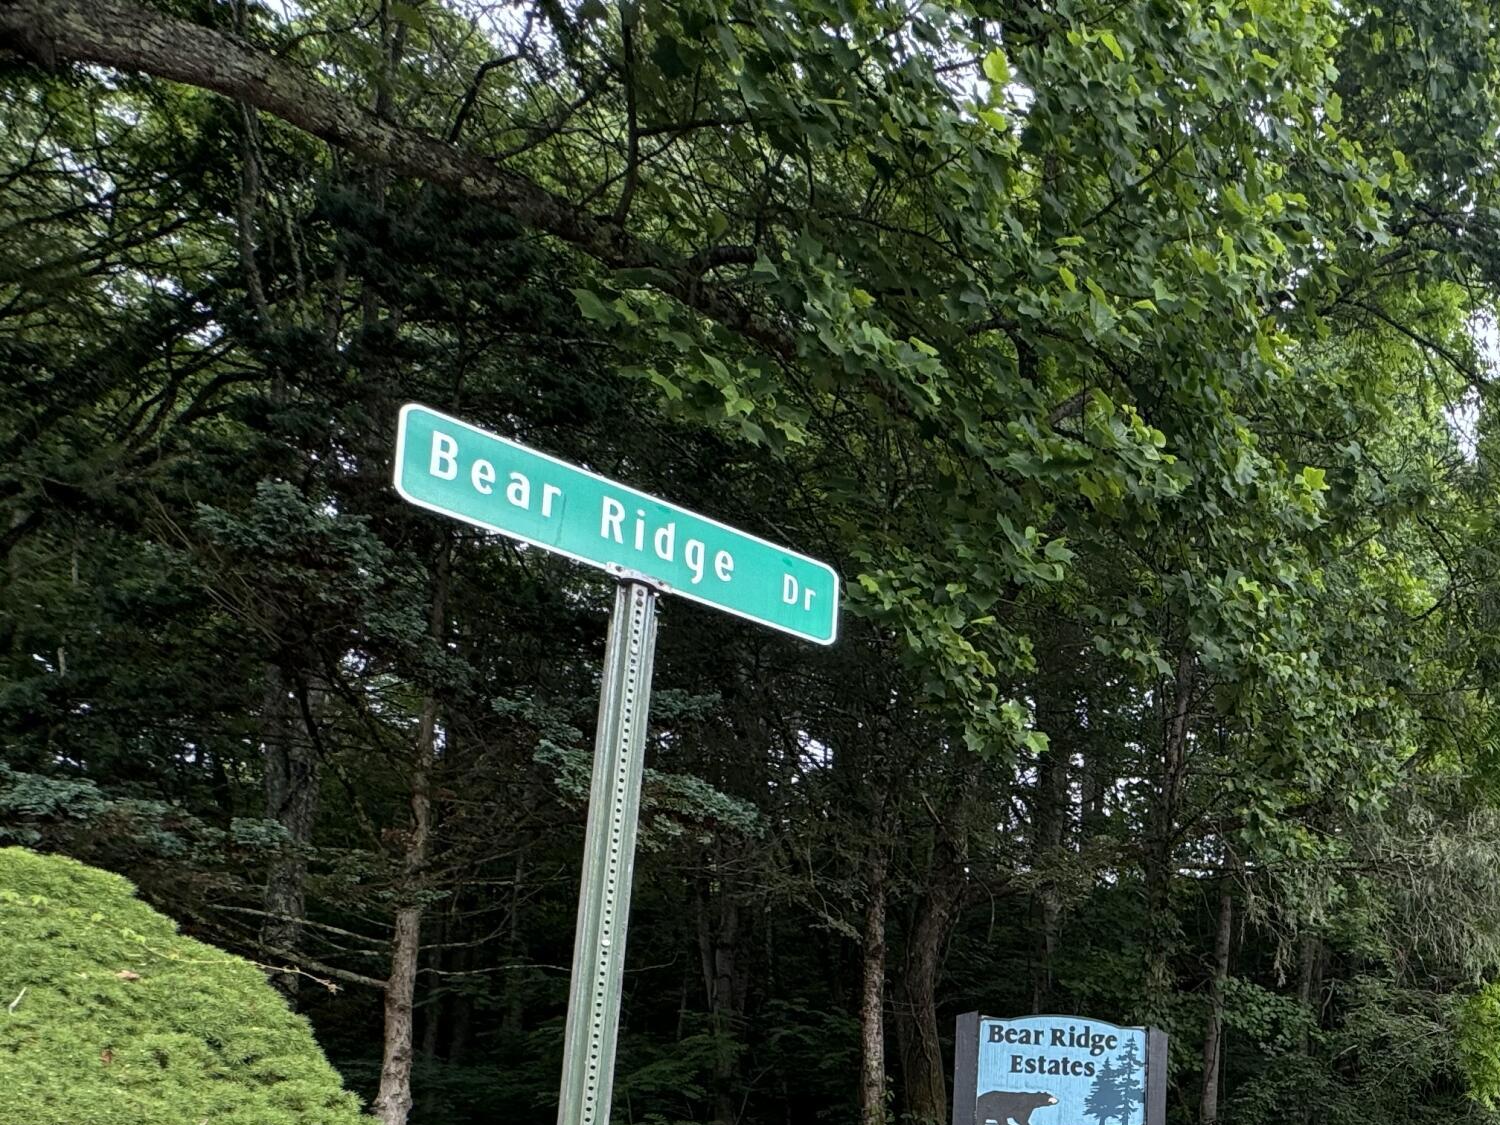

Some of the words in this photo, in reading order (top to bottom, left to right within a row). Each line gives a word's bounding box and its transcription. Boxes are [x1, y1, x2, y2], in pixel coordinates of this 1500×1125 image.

[429, 430, 562, 518] Bear
[600, 495, 735, 584] Ridge
[782, 573, 817, 611] Dr
[987, 1024, 1044, 1046] Bear
[1051, 1026, 1117, 1056] Ridge
[1010, 1055, 1095, 1077] Estates
